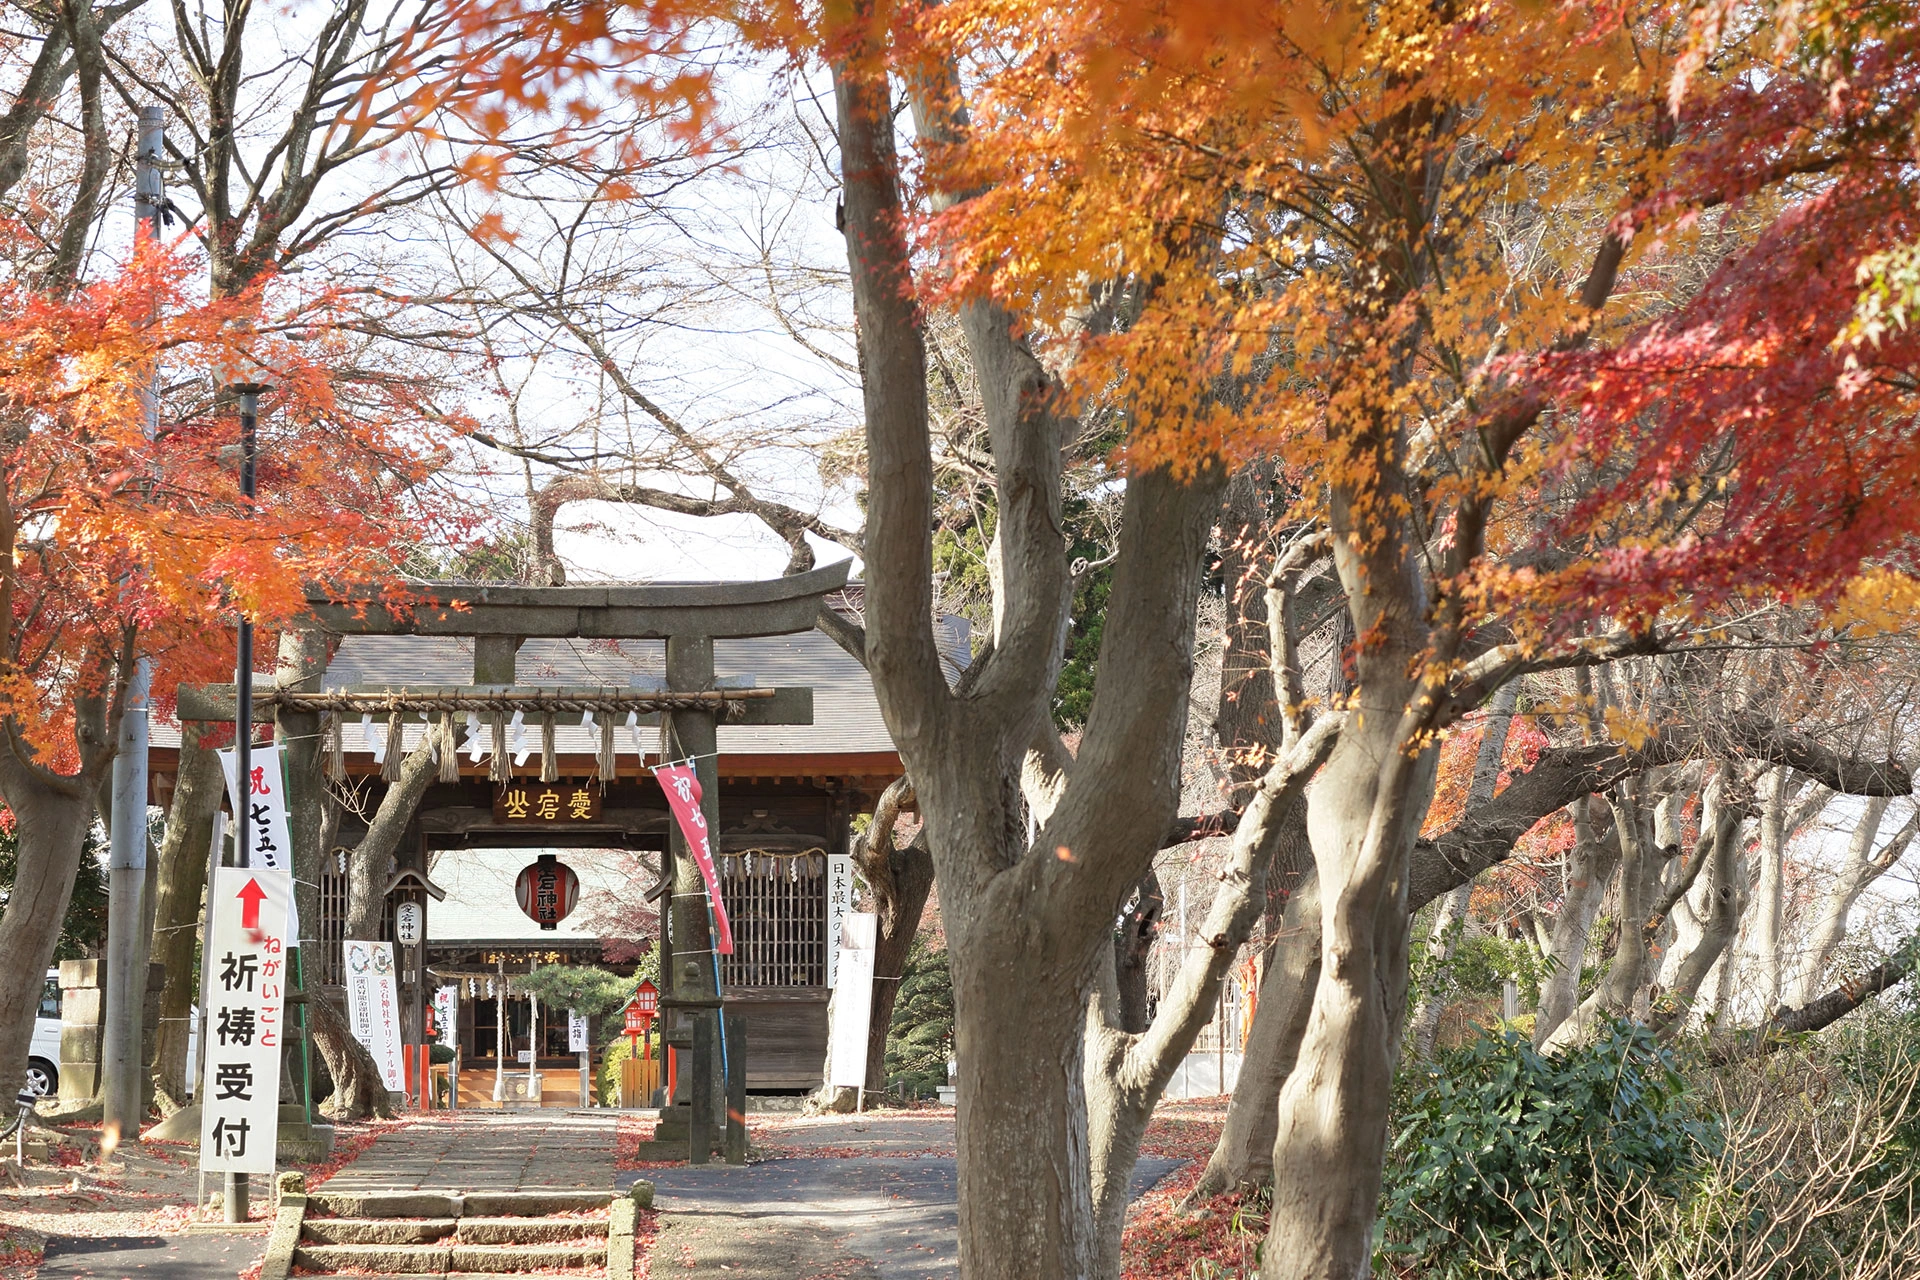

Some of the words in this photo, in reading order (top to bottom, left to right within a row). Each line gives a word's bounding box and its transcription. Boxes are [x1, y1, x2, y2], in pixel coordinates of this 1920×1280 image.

[401, 904, 416, 940] 愛宕神社
[260, 936, 282, 1047] ねがいごと
[211, 951, 258, 1158] 祈祷受付
